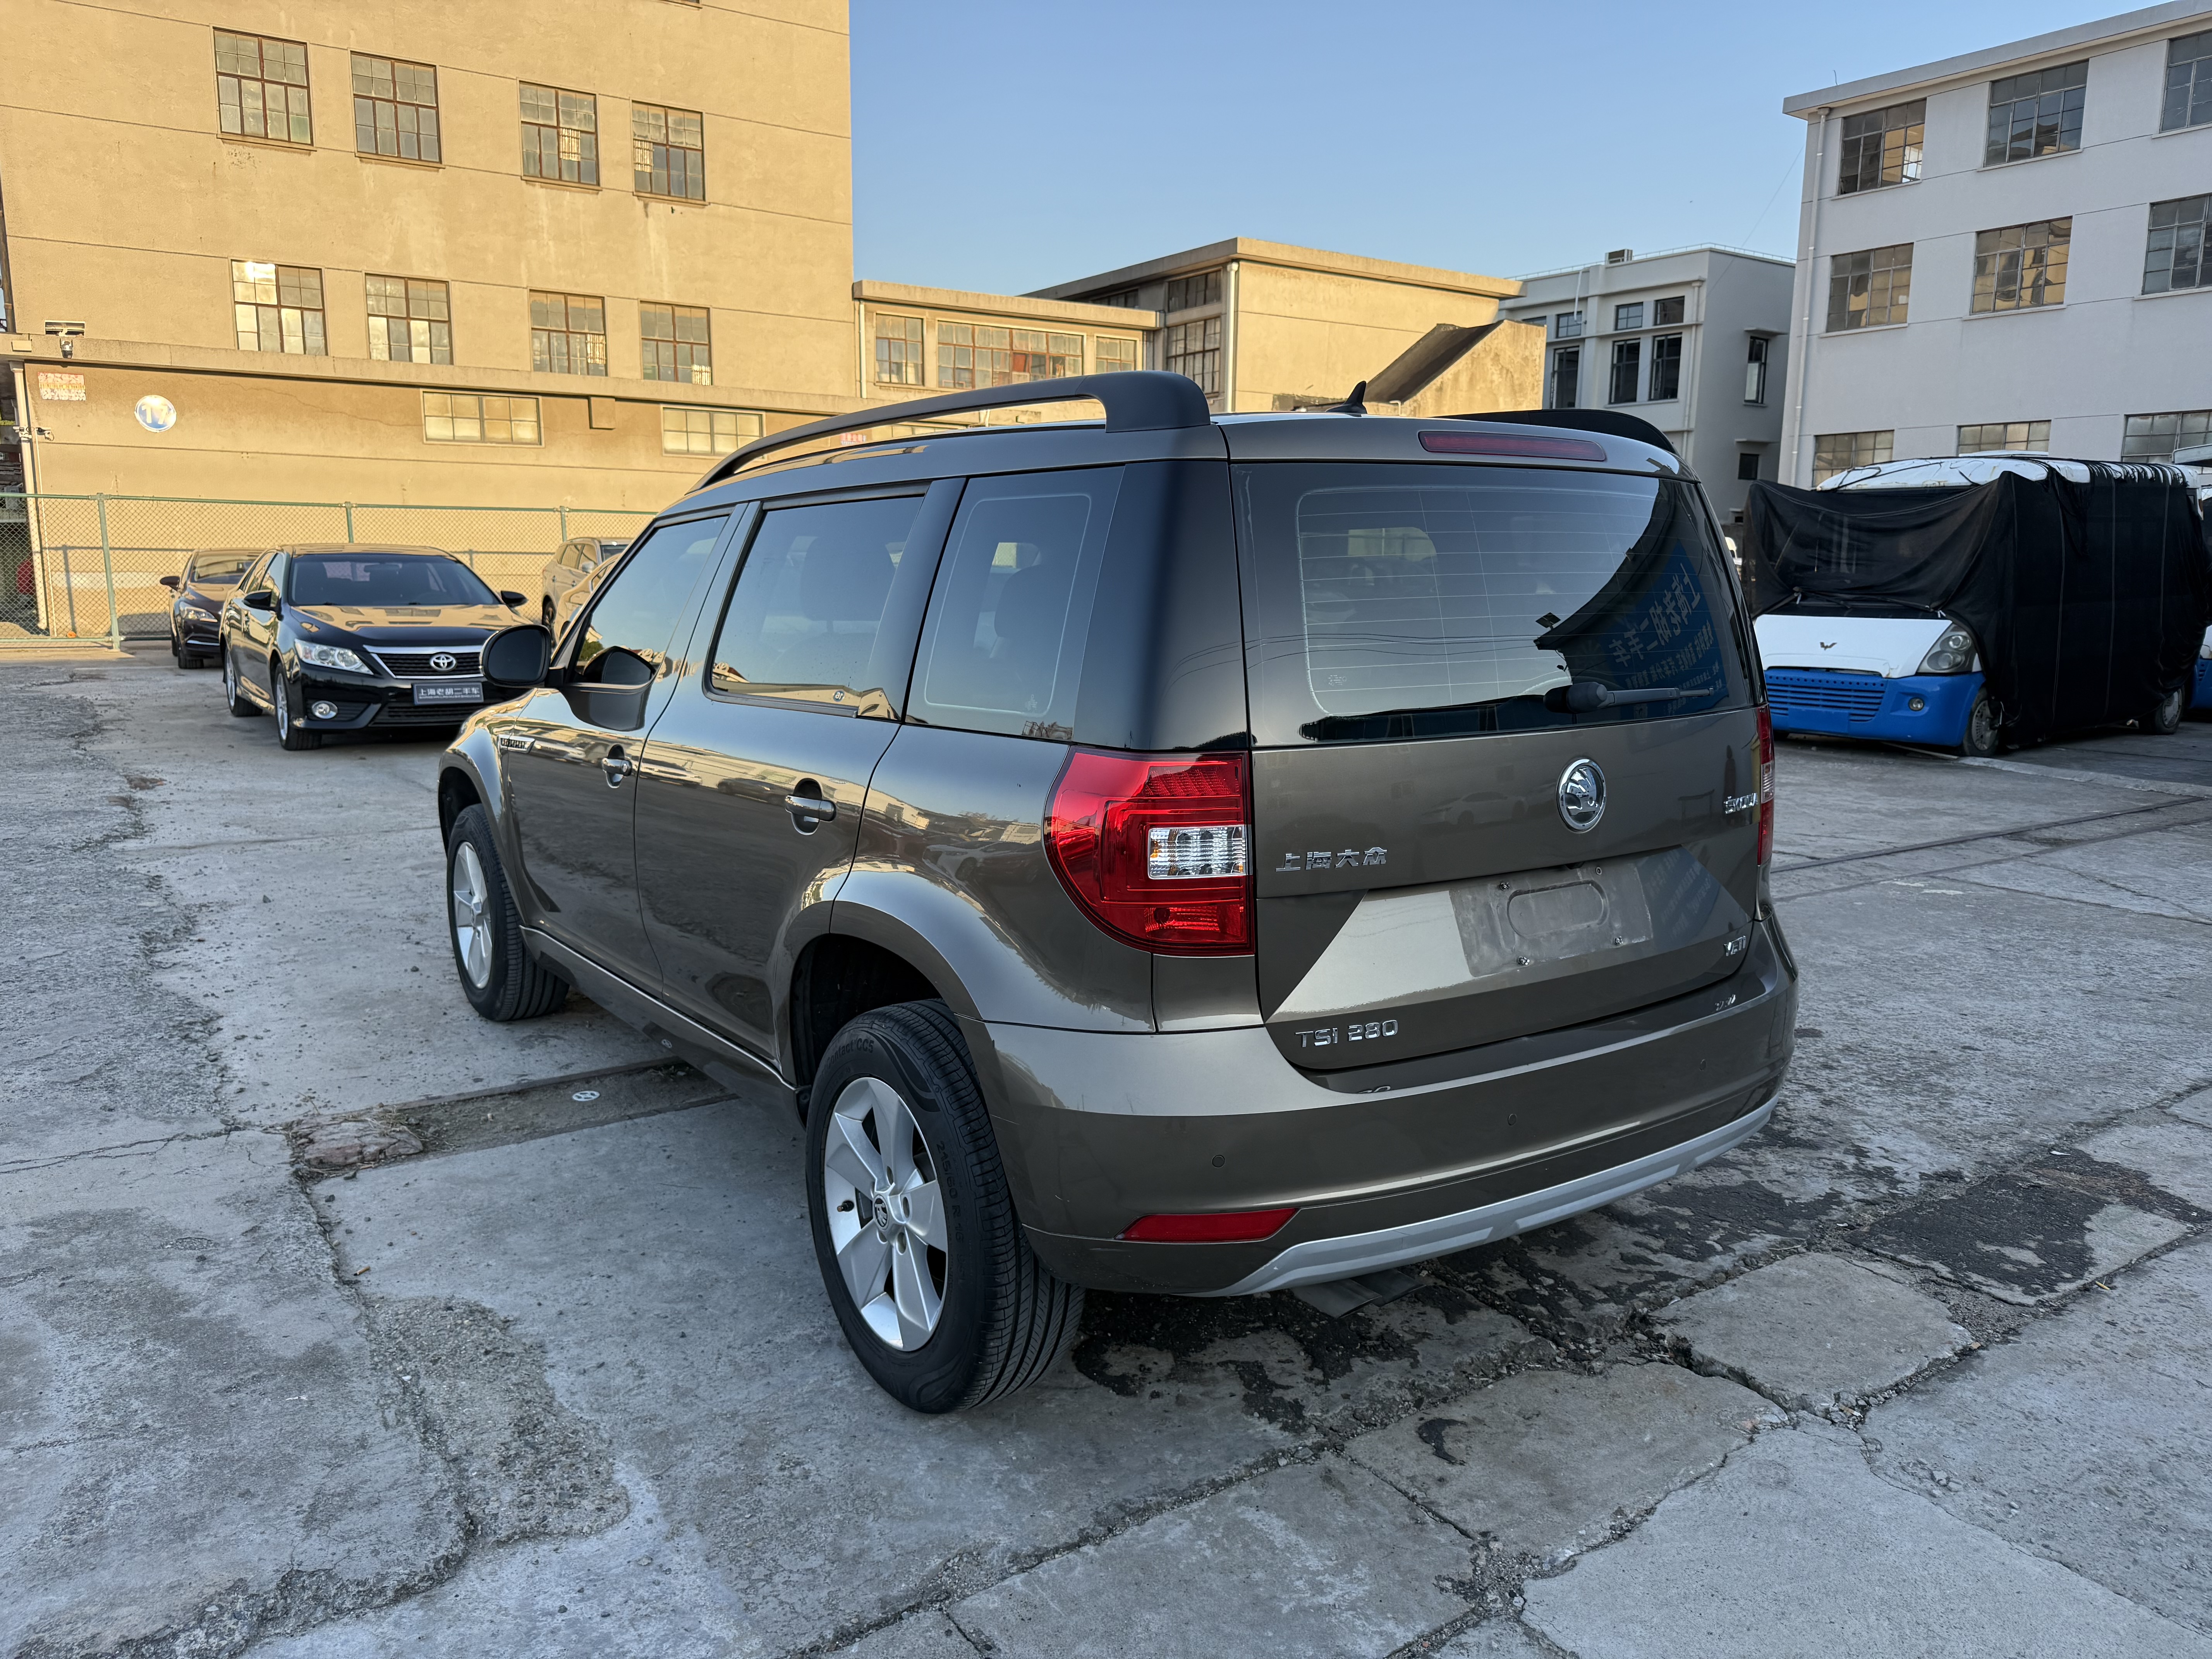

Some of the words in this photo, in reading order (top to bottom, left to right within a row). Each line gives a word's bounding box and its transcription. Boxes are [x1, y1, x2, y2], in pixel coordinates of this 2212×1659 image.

[142, 404, 168, 424] 17
[1276, 847, 1387, 872] 上海大众
[1723, 935, 1746, 957] YETI
[1295, 1028, 1338, 1048] TSI
[1348, 1020, 1398, 1041] 280
[936, 1140, 958, 1199] 215/60
[952, 1205, 961, 1219] R
